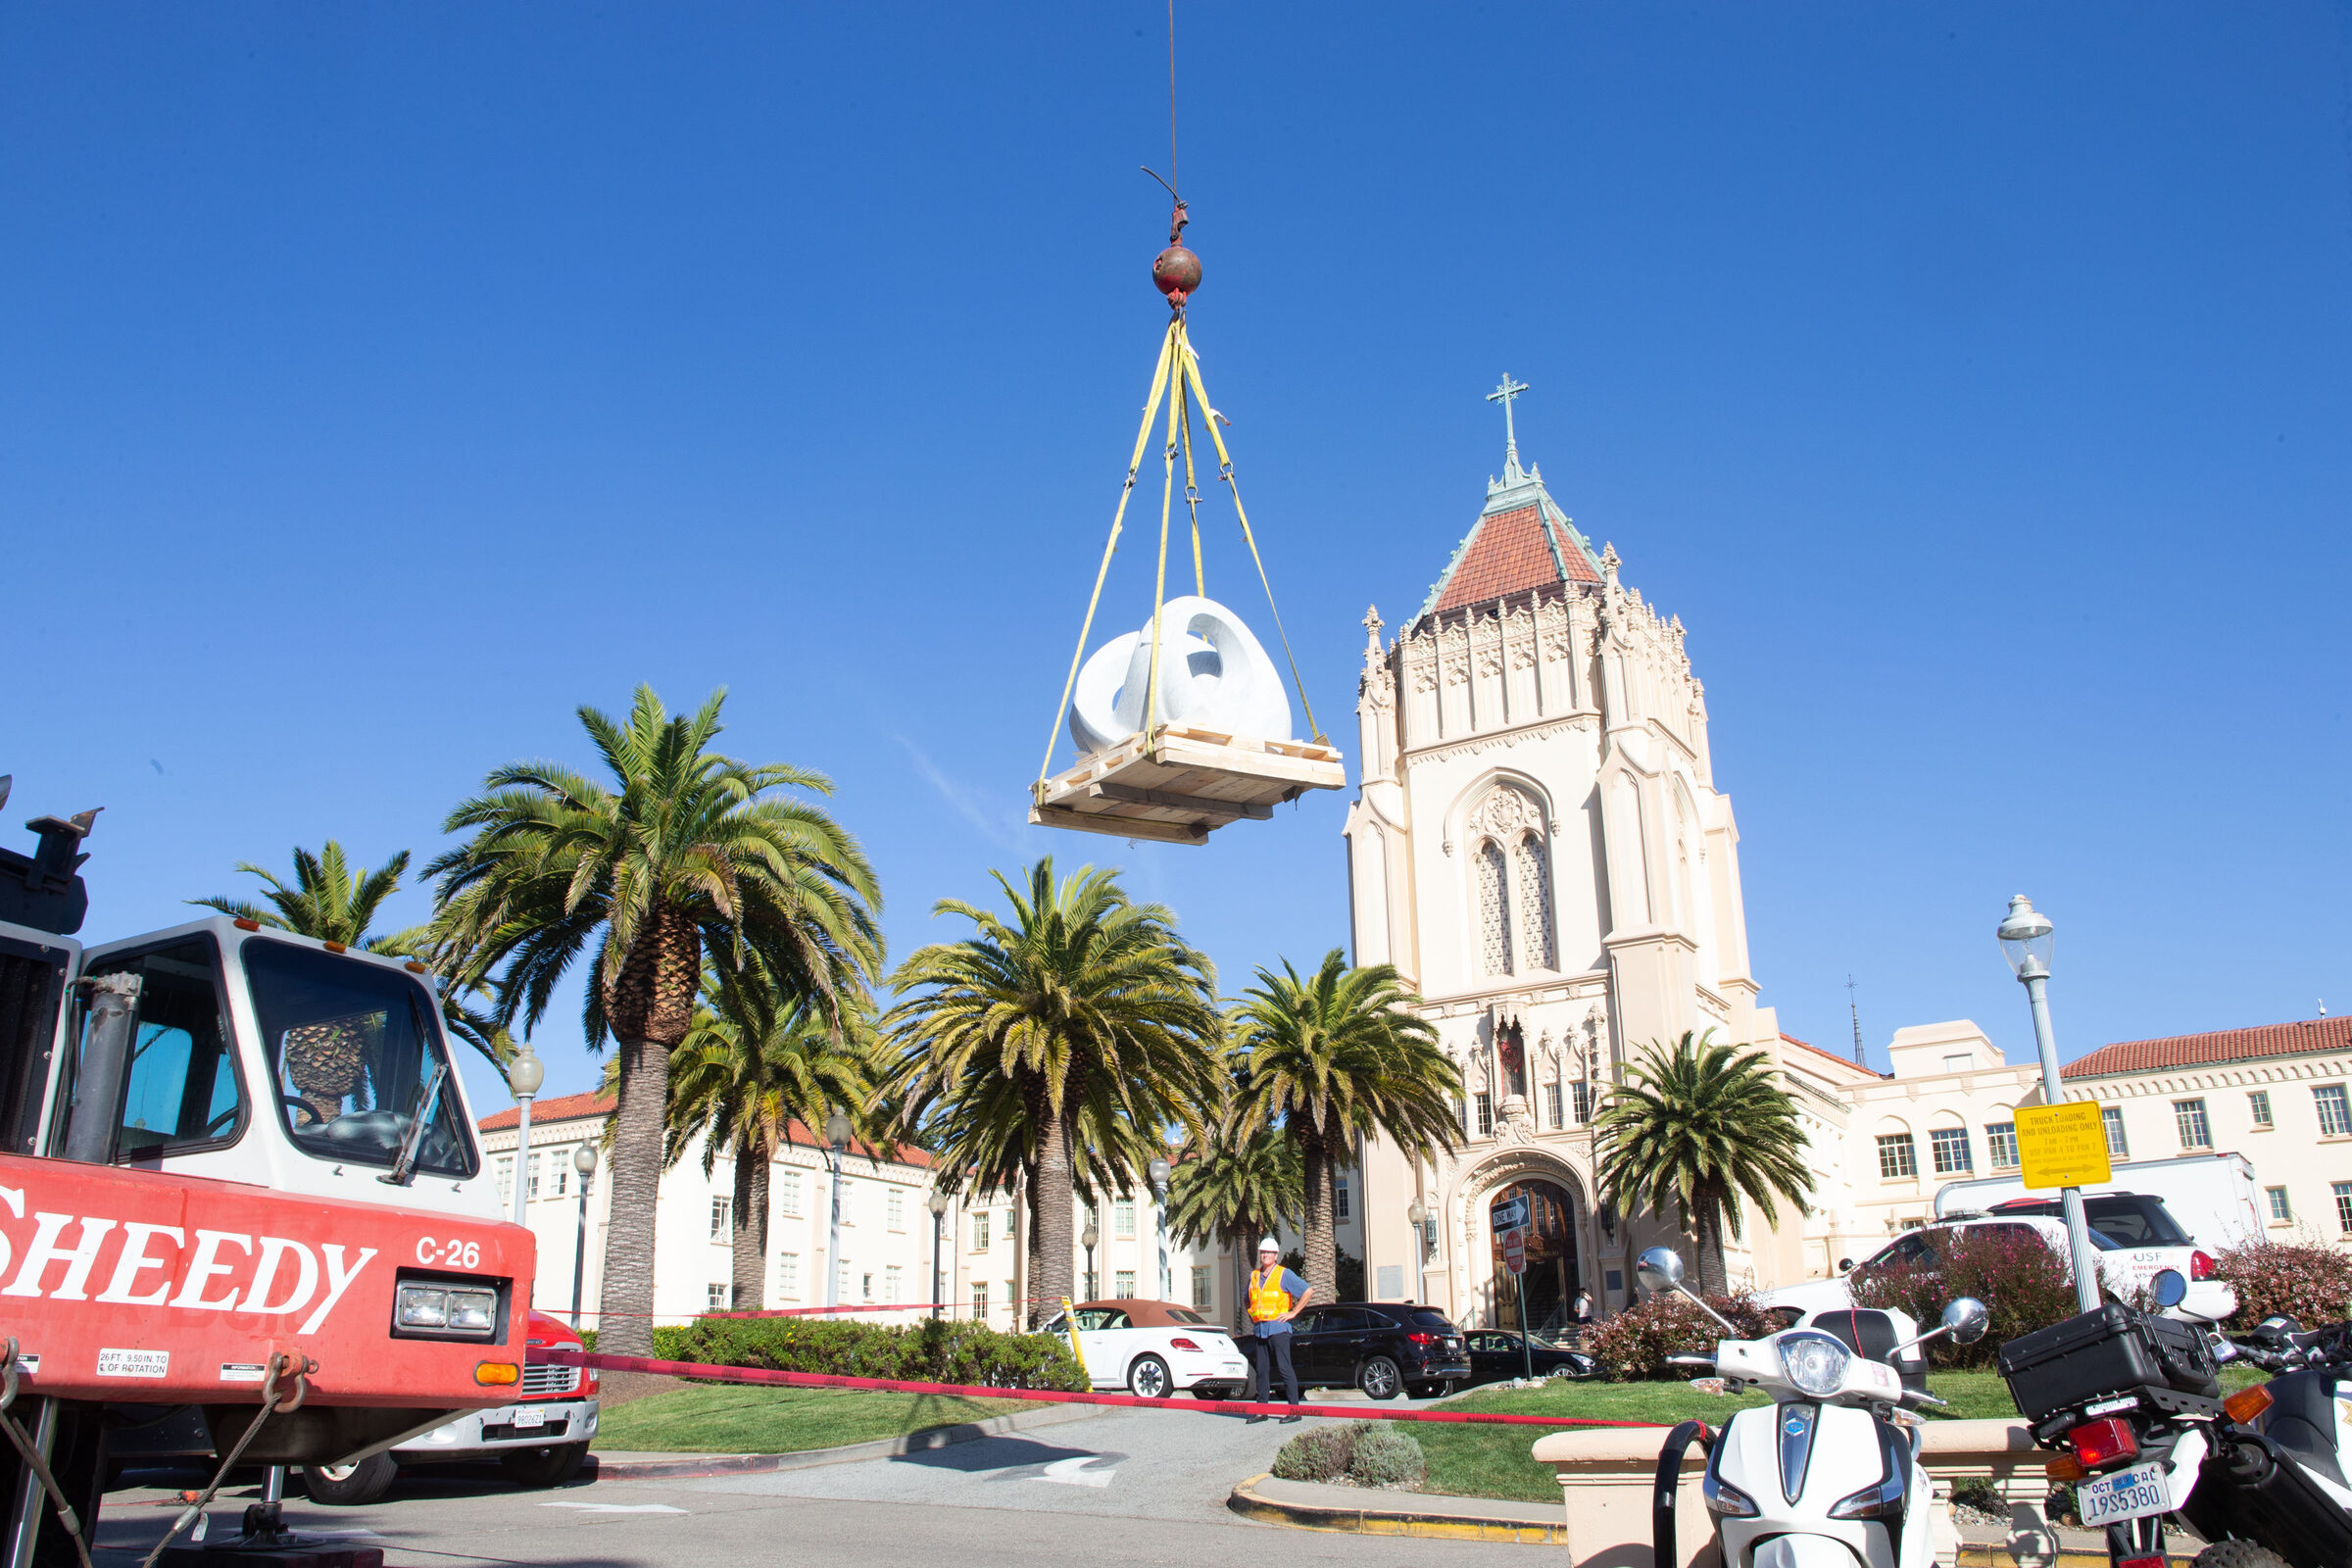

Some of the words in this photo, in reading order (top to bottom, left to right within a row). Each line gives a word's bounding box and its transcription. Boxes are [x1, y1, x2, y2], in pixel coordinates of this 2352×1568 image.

[2030, 1116, 2053, 1126] TRUCK
[2055, 1112, 2086, 1123] LOADING
[2022, 1128, 2035, 1137] AND
[2037, 1123, 2079, 1136] UNLOADING
[2080, 1121, 2098, 1131] ONLY
[1494, 1211, 1505, 1225] ONE
[1506, 1207, 1517, 1219] WAY
[416, 1237, 480, 1269] C-26
[2134, 1251, 2163, 1262] USF
[156, 1355, 168, 1364] TO
[108, 1363, 120, 1372] OF
[122, 1363, 166, 1374] ROTATION
[2091, 1481, 2111, 1494] OCT
[2132, 1471, 2156, 1484] CAL
[2089, 1484, 2160, 1517] 19S5380
